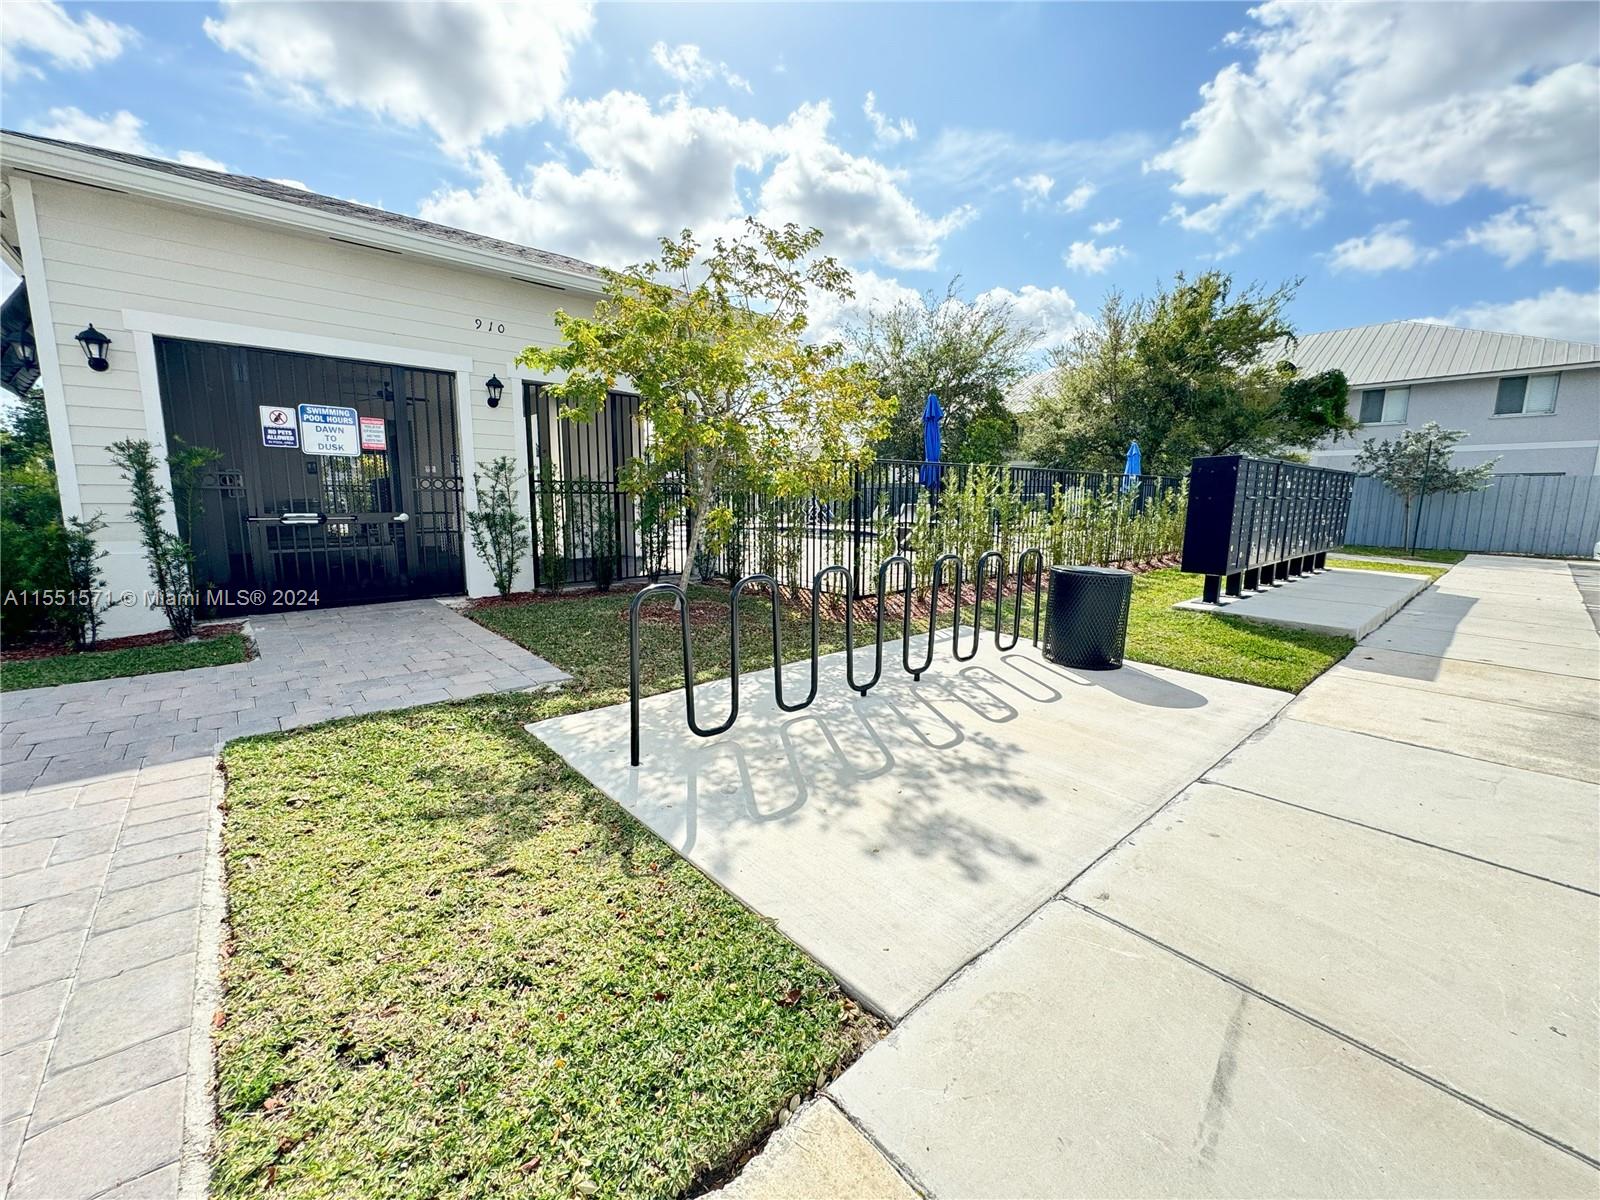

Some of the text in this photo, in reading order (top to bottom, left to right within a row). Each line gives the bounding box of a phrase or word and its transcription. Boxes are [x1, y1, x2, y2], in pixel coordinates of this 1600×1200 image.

[475, 318, 505, 334] 910
[306, 407, 350, 417] SWIMMING
[303, 414, 326, 423] POOL
[326, 415, 354, 424] HOURS
[315, 425, 345, 434] DAWN
[324, 434, 337, 442] TO
[318, 443, 345, 451] DUSK
